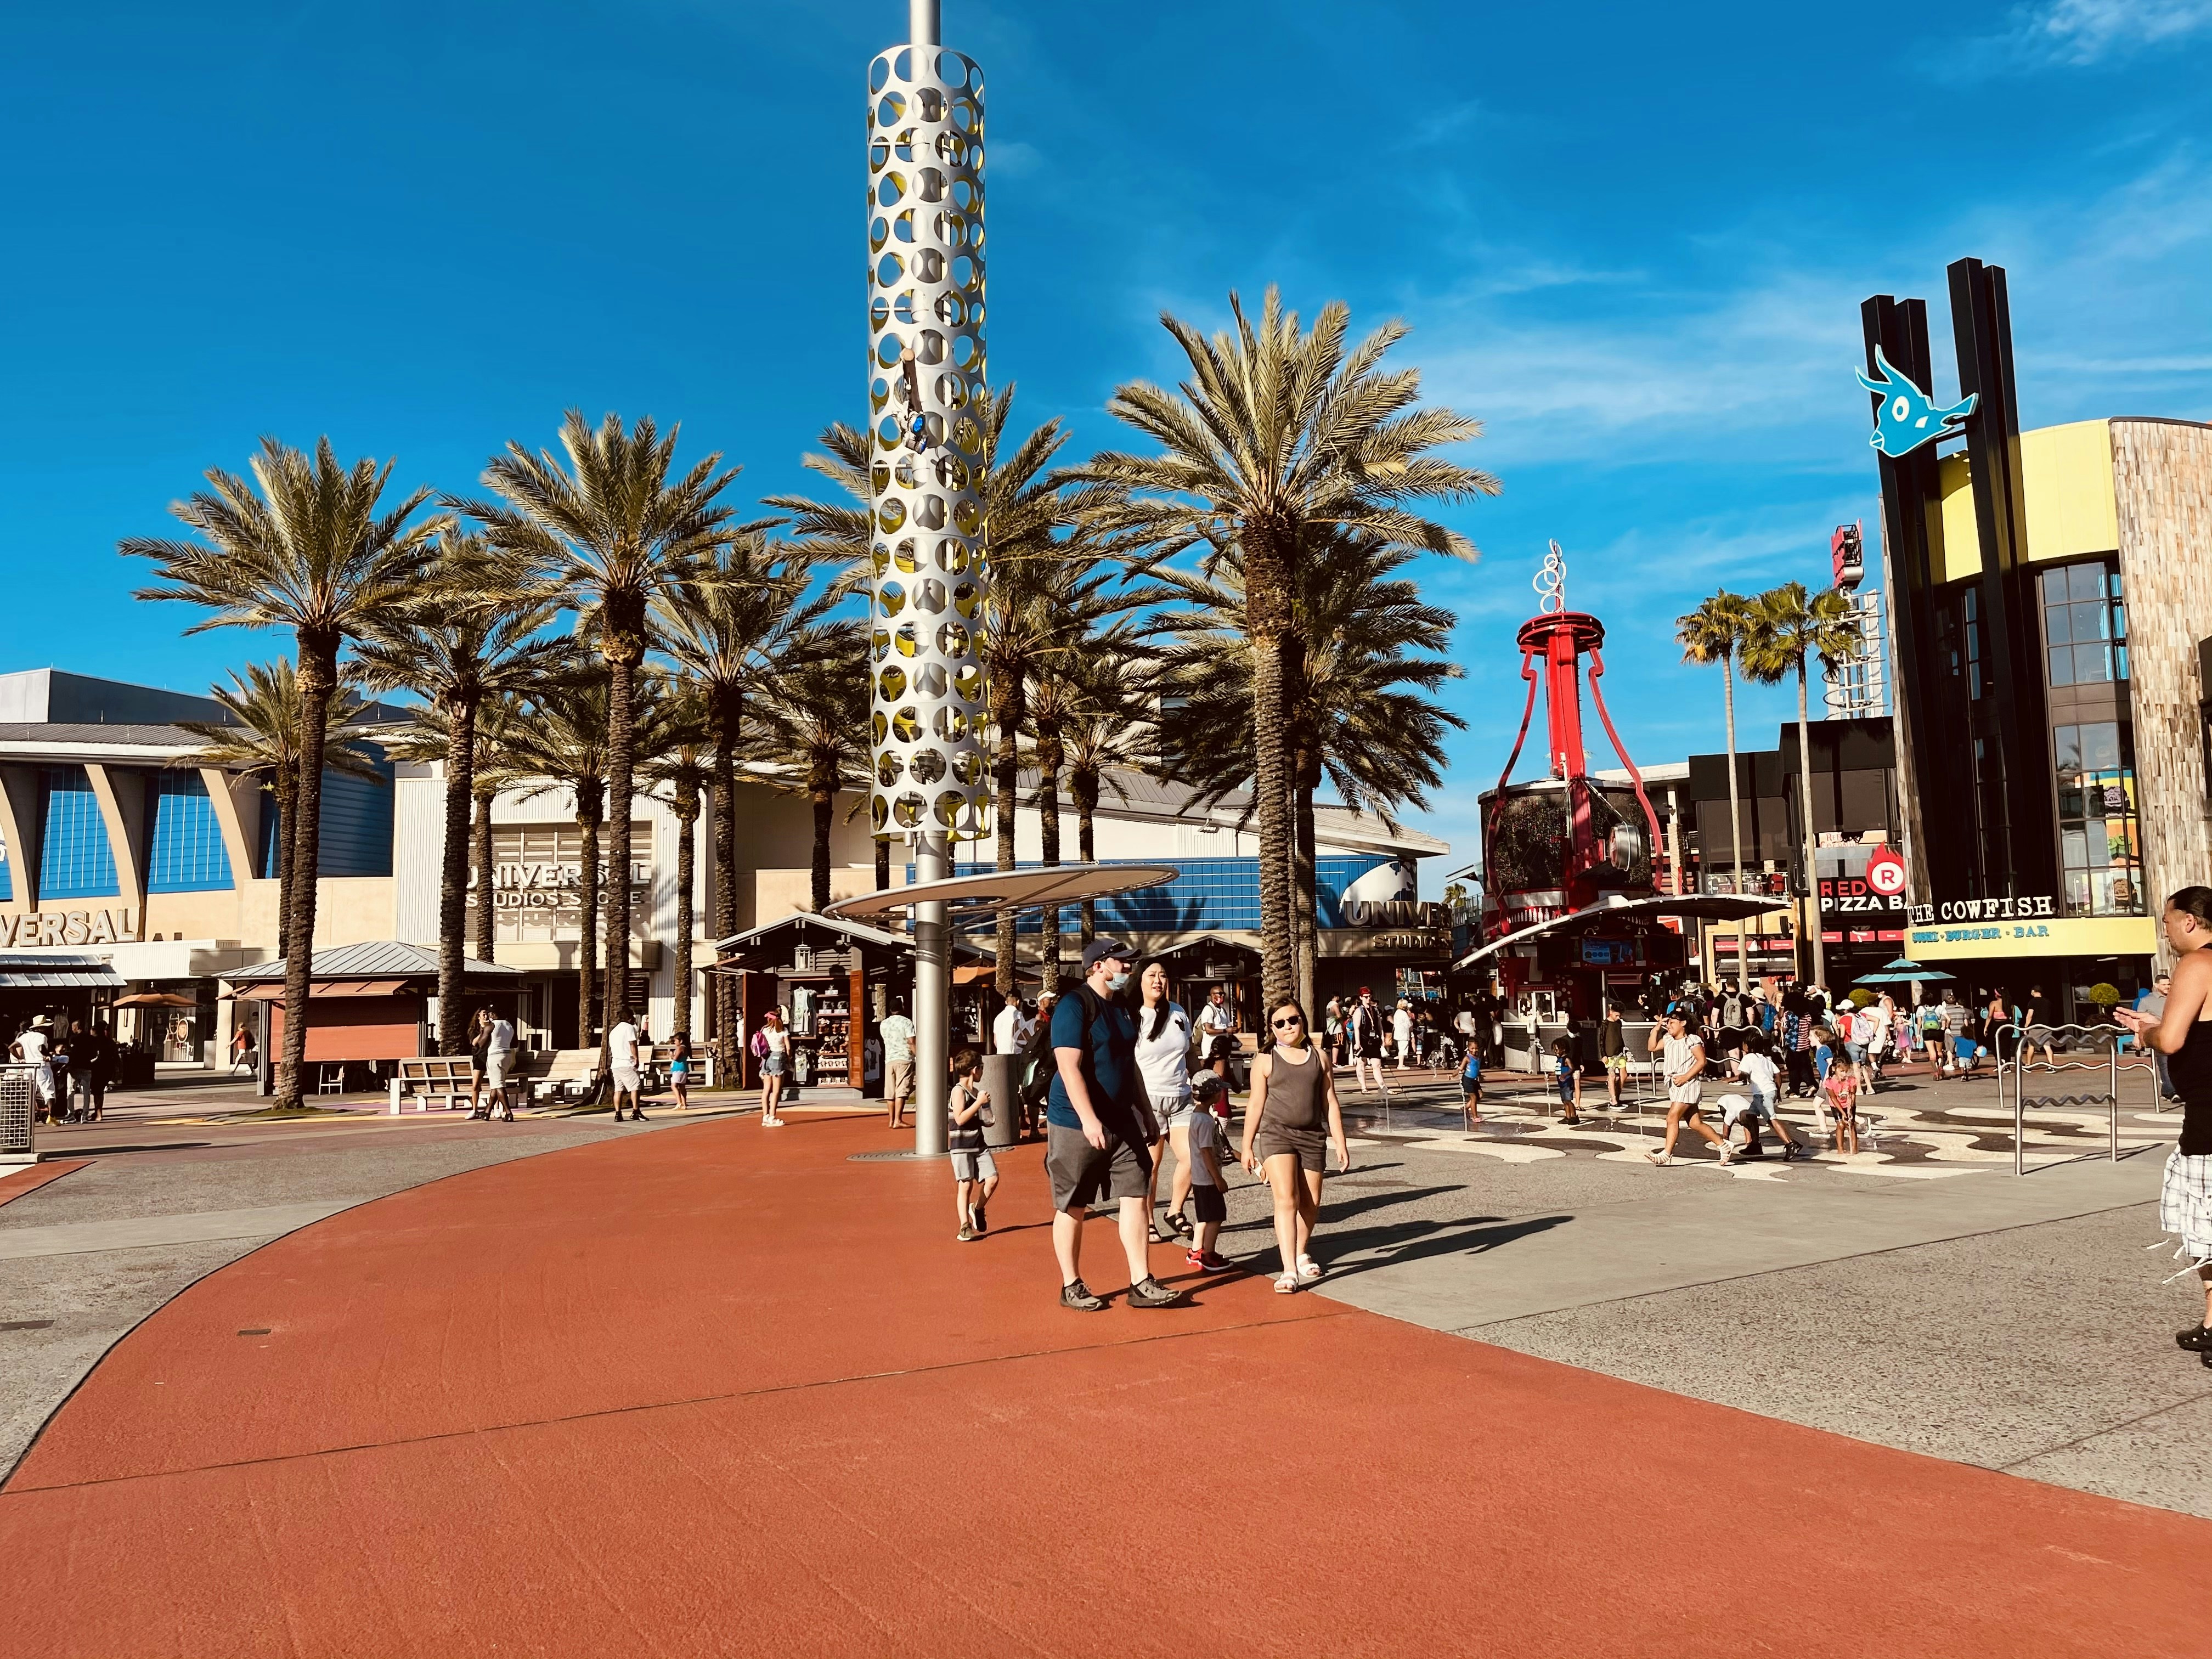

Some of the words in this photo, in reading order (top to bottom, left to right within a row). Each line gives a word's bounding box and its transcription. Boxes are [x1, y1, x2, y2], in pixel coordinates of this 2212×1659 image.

[1881, 870, 1895, 884] R
[1820, 880, 1867, 896] RED
[465, 892, 559, 907] SUDIOS
[569, 891, 641, 906] SOE
[1821, 895, 1883, 912] PIZZA
[1907, 904, 1934, 923] THE
[1941, 895, 2053, 920] COWFISH
[1945, 927, 2002, 941] BURGER
[2013, 926, 2050, 938] BAR
